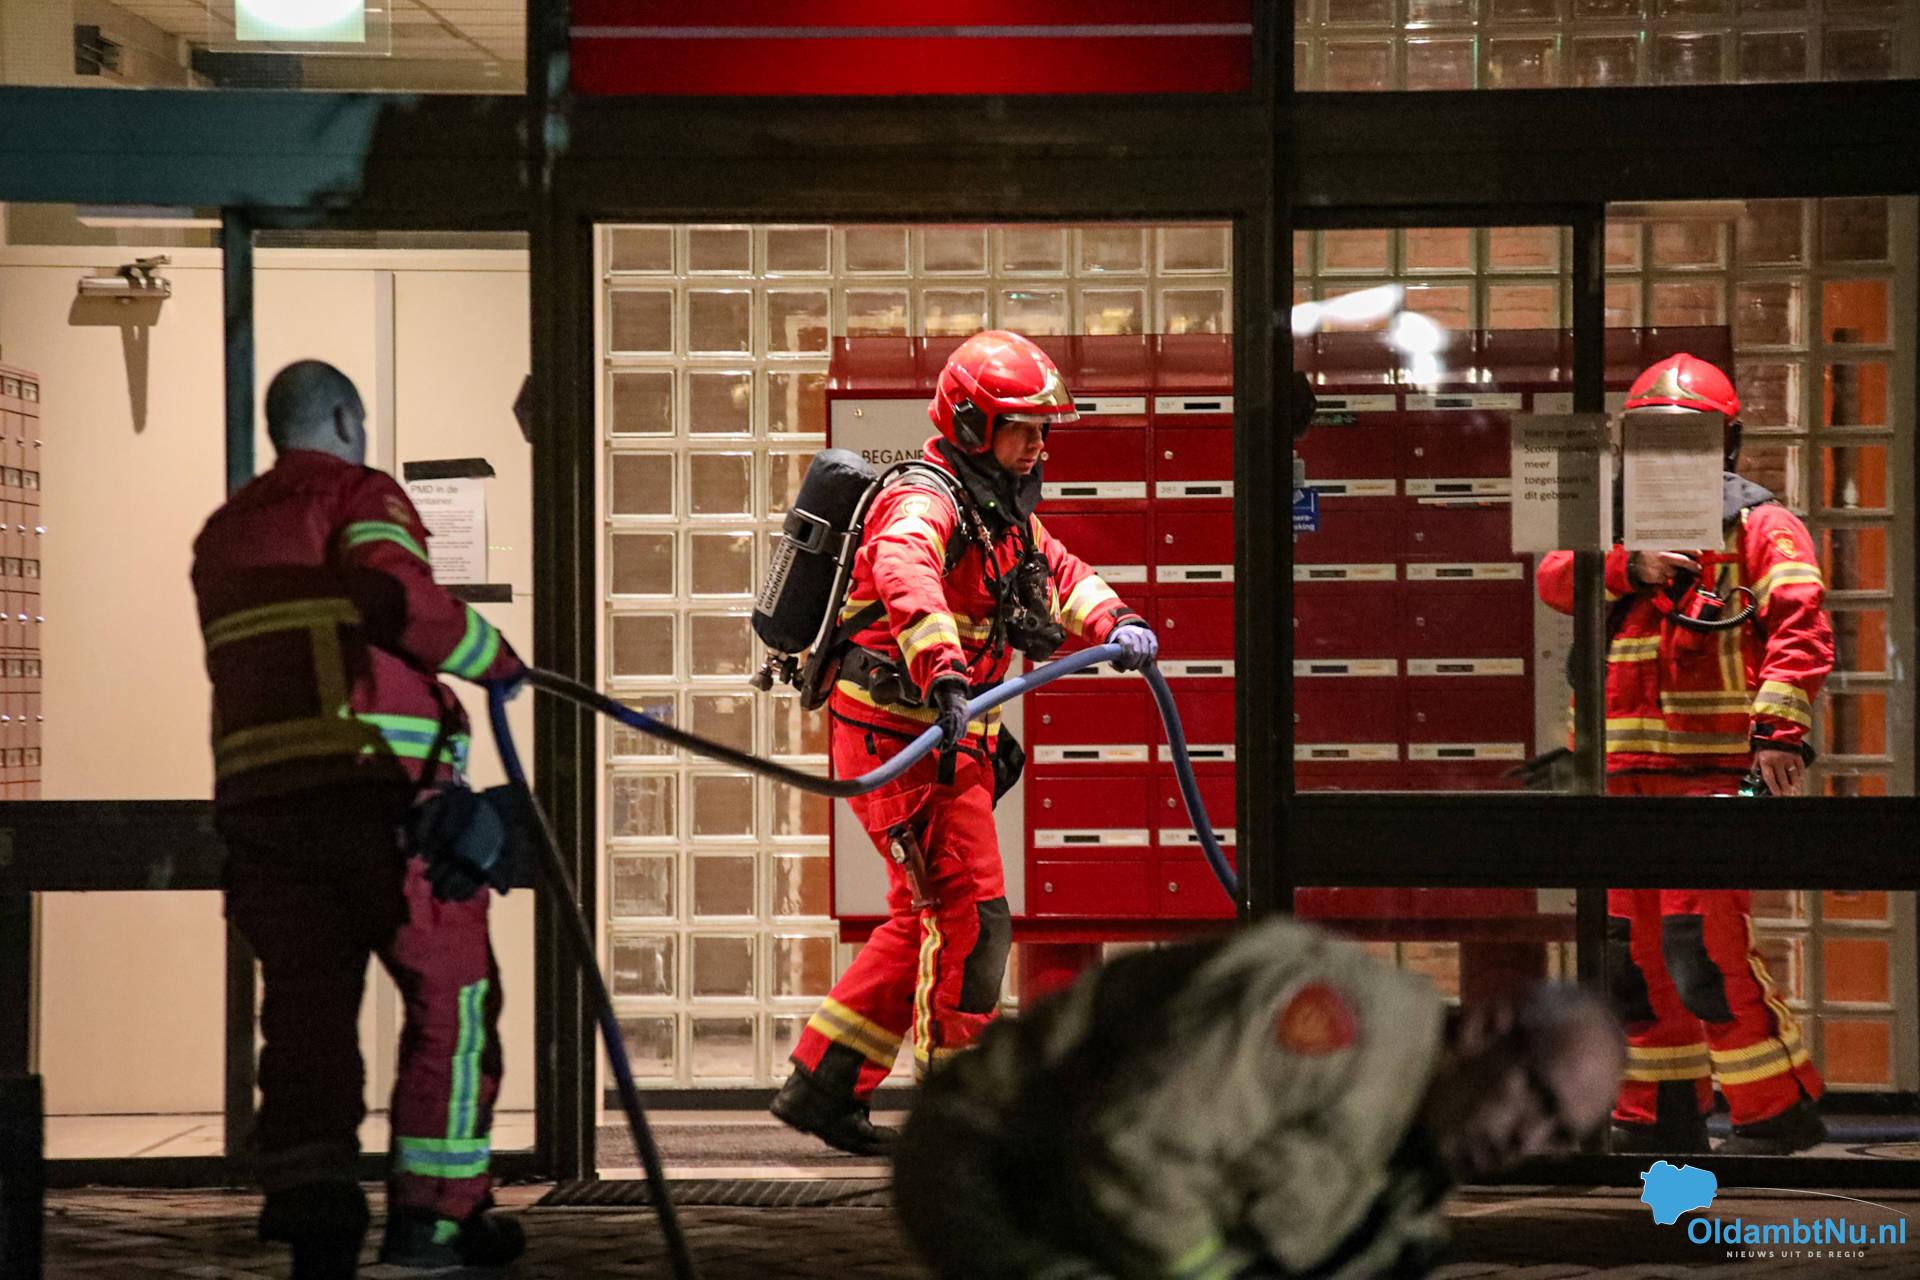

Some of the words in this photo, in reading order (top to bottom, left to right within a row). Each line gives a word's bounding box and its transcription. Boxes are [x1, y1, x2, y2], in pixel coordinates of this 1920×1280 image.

[1524, 461, 1550, 469] meer
[411, 485, 433, 494] PMD
[436, 485, 445, 494] in
[447, 485, 458, 494] de
[1524, 491, 1537, 500] dit
[1539, 491, 1579, 501] gebouw
[764, 545, 794, 610] GRONINGEN
